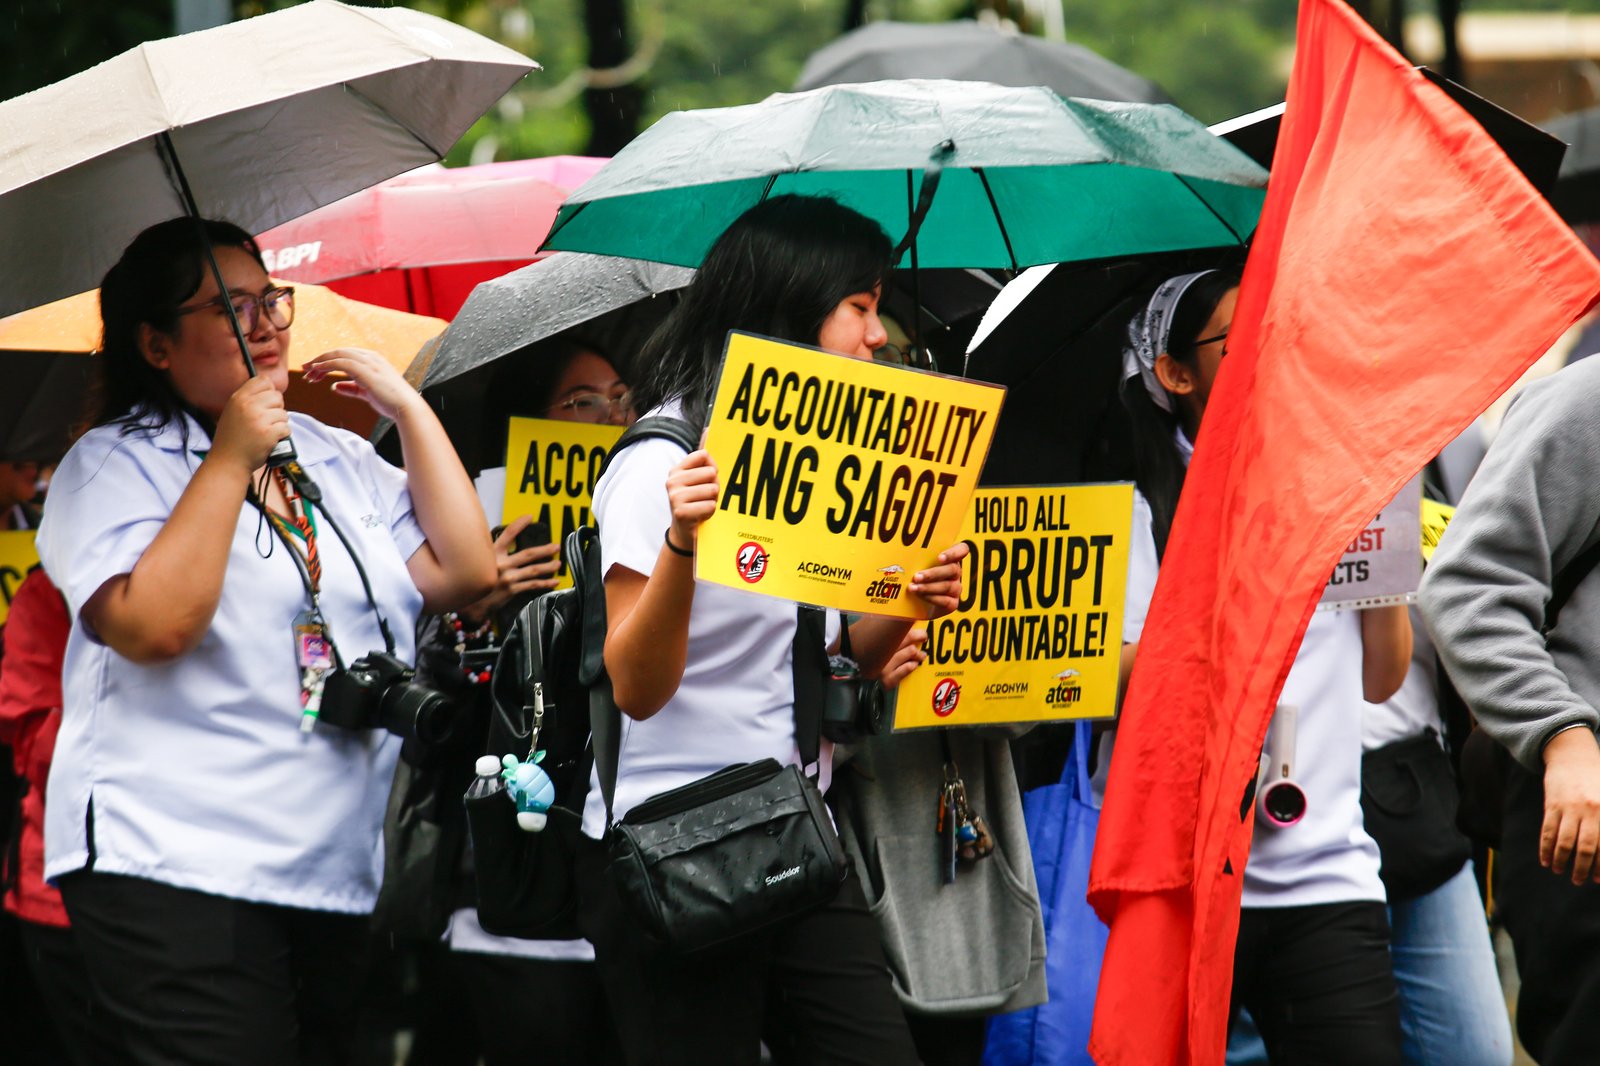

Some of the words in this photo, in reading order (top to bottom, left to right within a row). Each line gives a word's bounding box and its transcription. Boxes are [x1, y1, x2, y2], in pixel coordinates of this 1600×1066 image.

[277, 241, 322, 271] BPI
[727, 362, 987, 467] ACCOUNTABILITY
[720, 433, 819, 525] ANG
[826, 454, 957, 549] SAGOT
[975, 496, 1027, 533] HOLD
[1033, 495, 1070, 531] ALL
[797, 561, 853, 581] ACRONYM
[957, 534, 1113, 613] ORRUPT
[1328, 560, 1369, 585] CTS
[919, 612, 1108, 666] ACCOUNTABLE!
[984, 682, 1029, 695] ACRONYM
